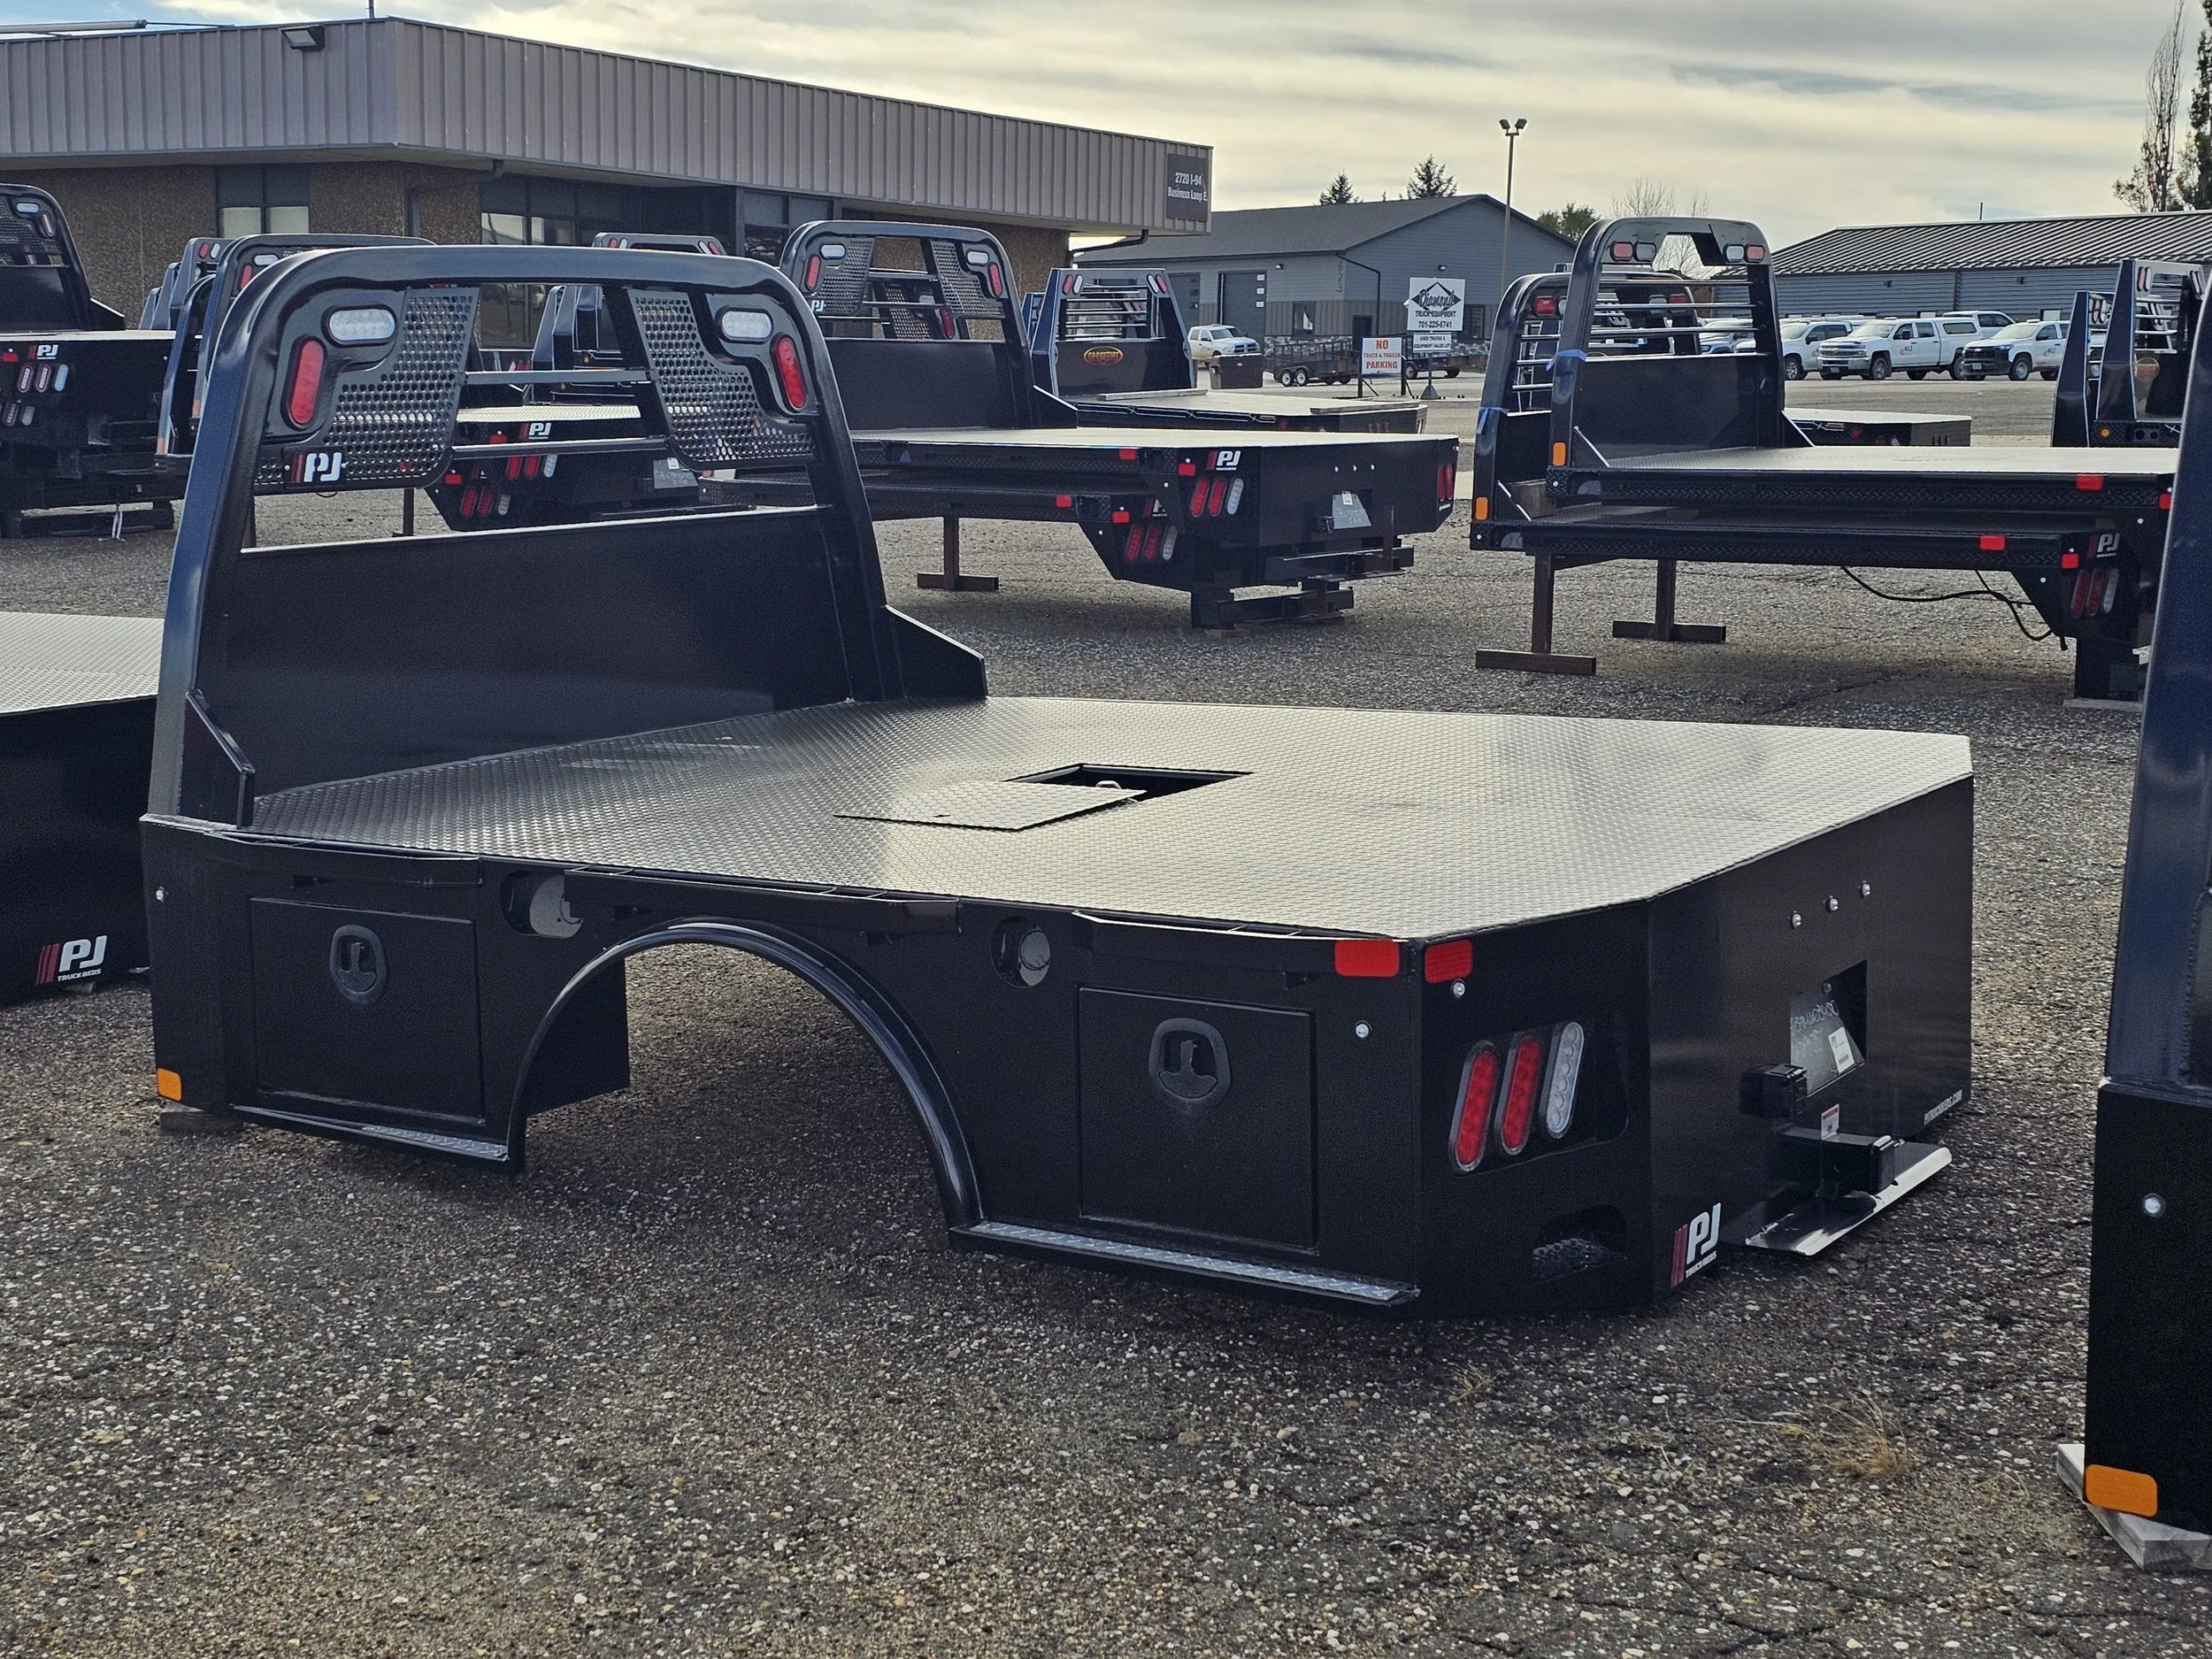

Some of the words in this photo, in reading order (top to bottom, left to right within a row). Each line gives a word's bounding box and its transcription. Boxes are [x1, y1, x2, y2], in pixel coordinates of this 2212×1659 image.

[1175, 172, 1189, 184] 2720
[1190, 173, 1202, 186] I-94
[1168, 187, 1190, 199] Business
[1191, 189, 1202, 203] Loop
[1419, 288, 1455, 307] Diamond
[811, 300, 824, 311] PJ
[37, 344, 58, 356] PJ
[1376, 340, 1388, 349] NO
[528, 423, 551, 435] PJ
[1217, 450, 1240, 465] PJ
[303, 452, 342, 482] PJ
[2097, 533, 2120, 552] PJ
[58, 935, 107, 972] PJ
[81, 968, 102, 977] BEDS
[1686, 1202, 1721, 1264] PJ
[1686, 1260, 1702, 1279] TRUCK
